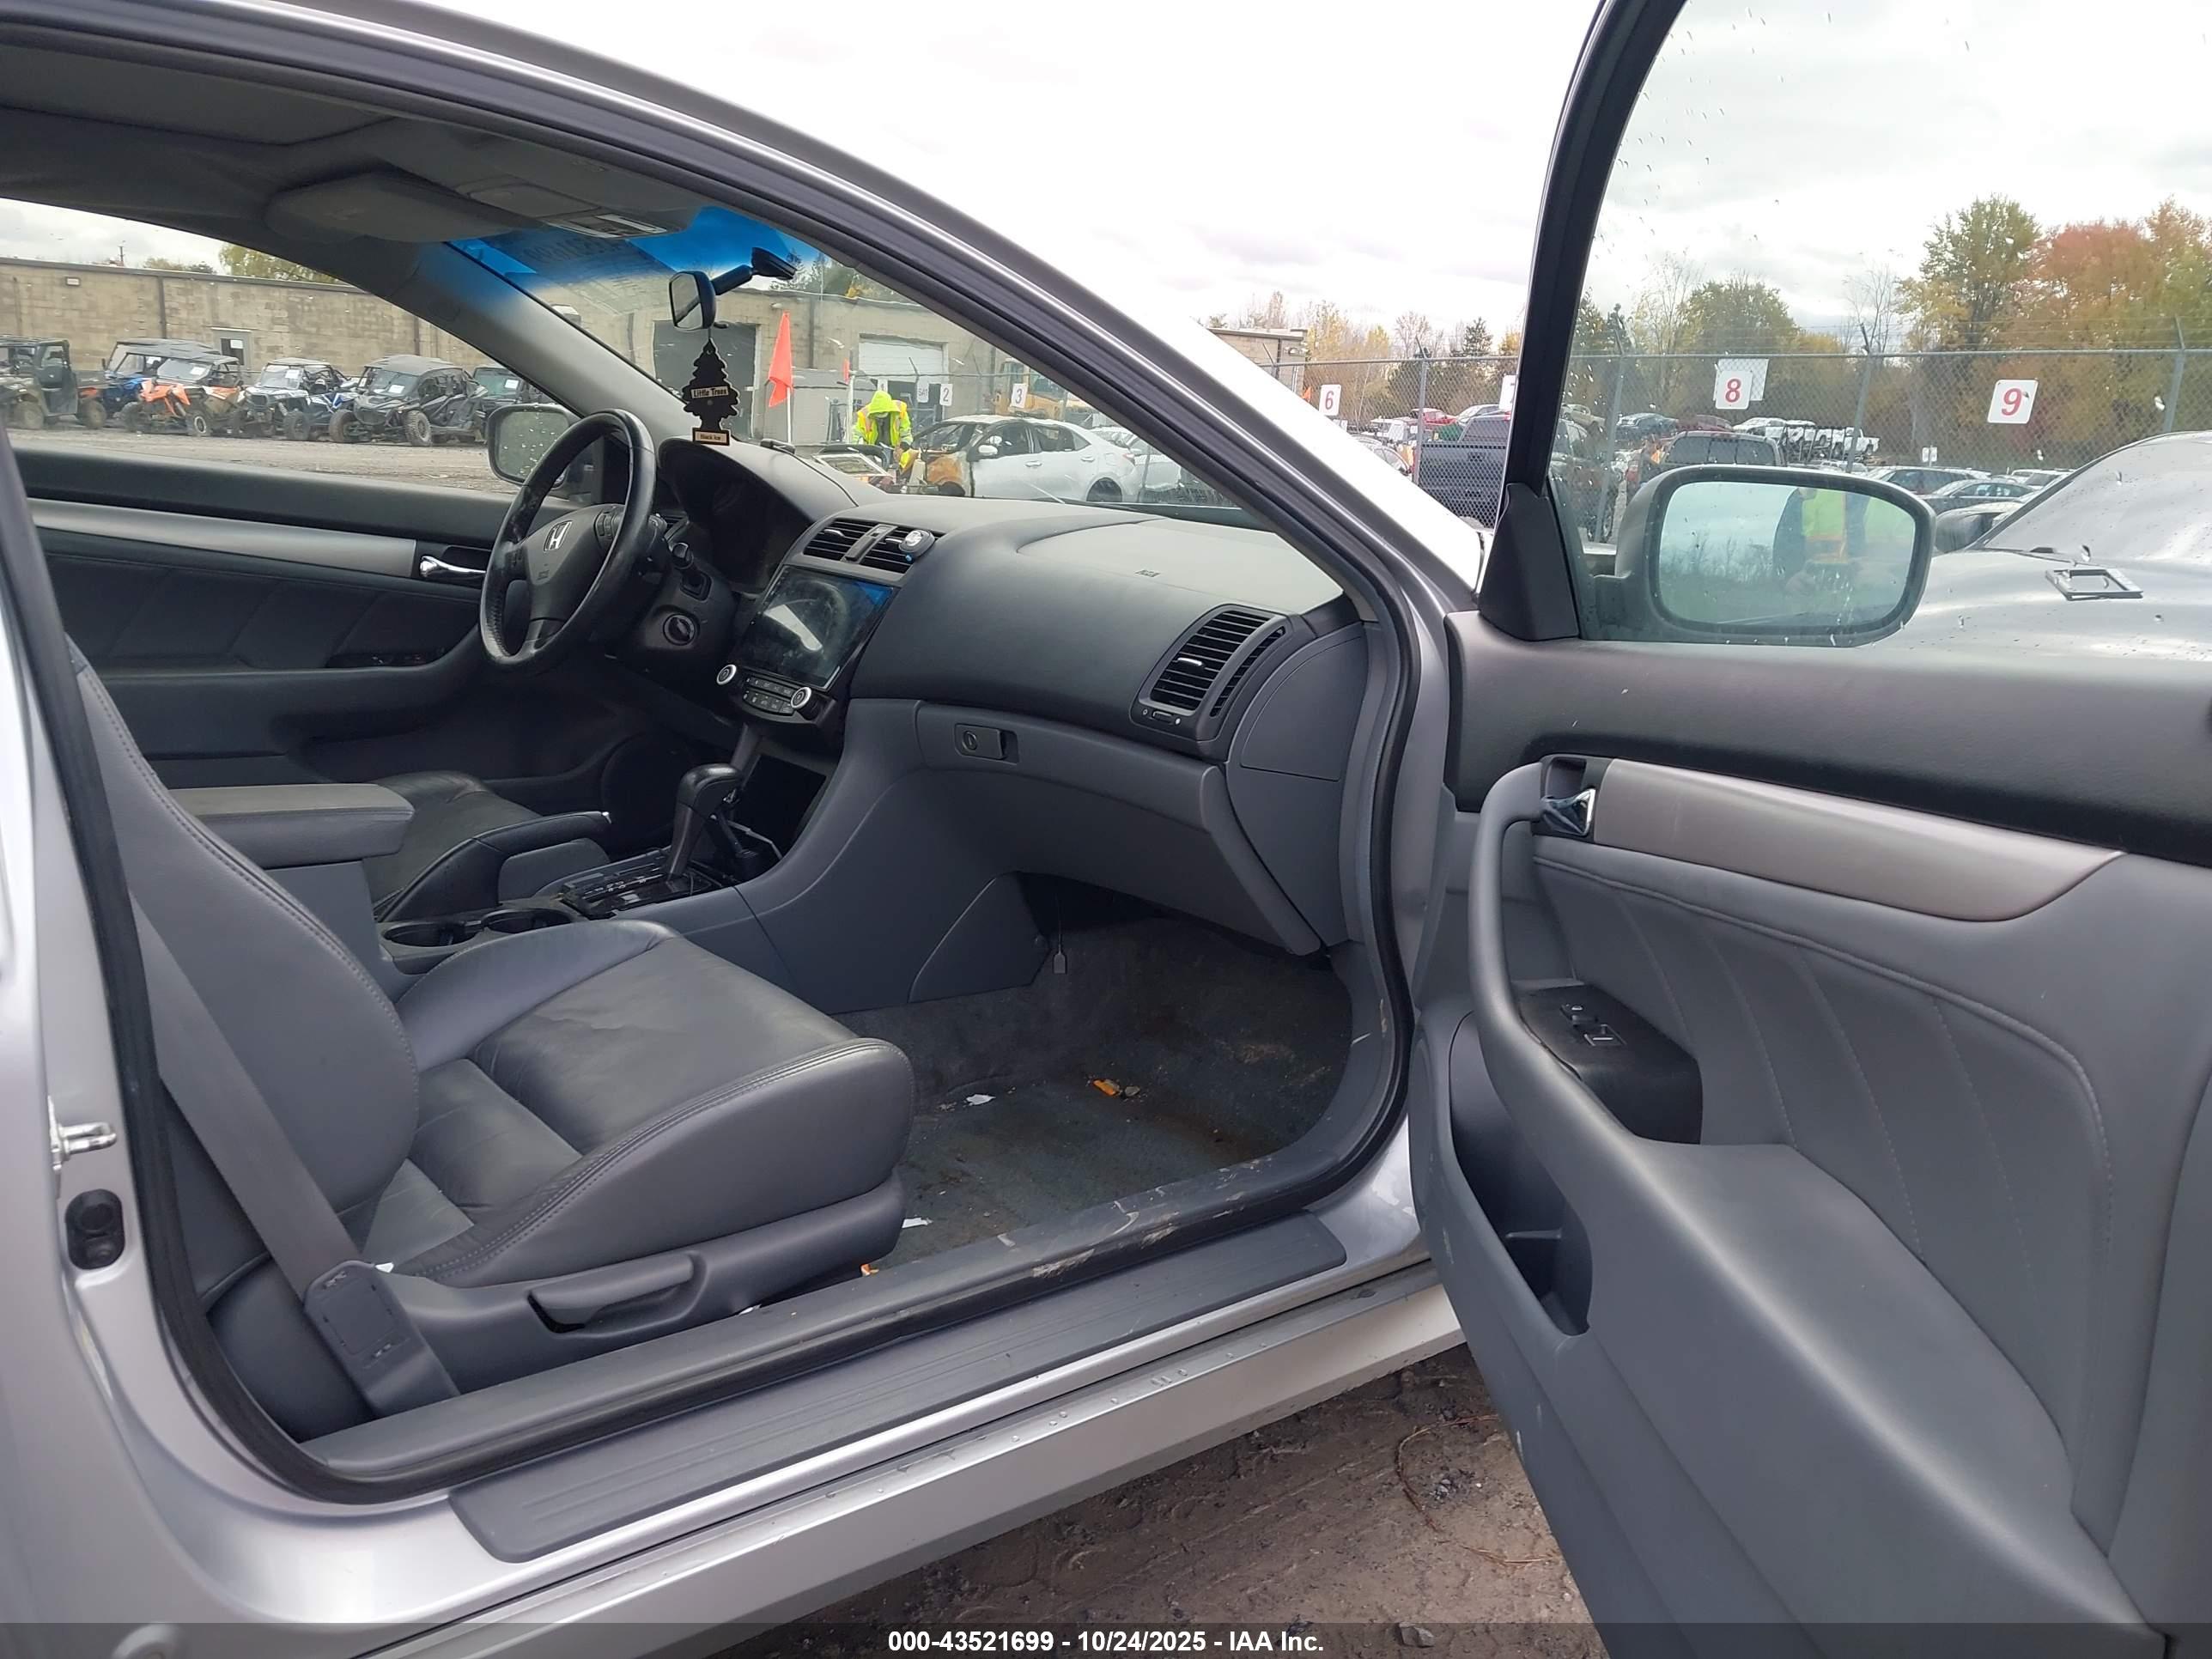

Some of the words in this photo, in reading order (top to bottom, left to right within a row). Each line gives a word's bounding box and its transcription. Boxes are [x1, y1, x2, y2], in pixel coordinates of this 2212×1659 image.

[943, 387, 950, 402] 2
[1015, 388, 1023, 404] 3
[1725, 378, 1741, 403] 8
[1325, 391, 1334, 410] 6
[2001, 387, 2022, 416] 9
